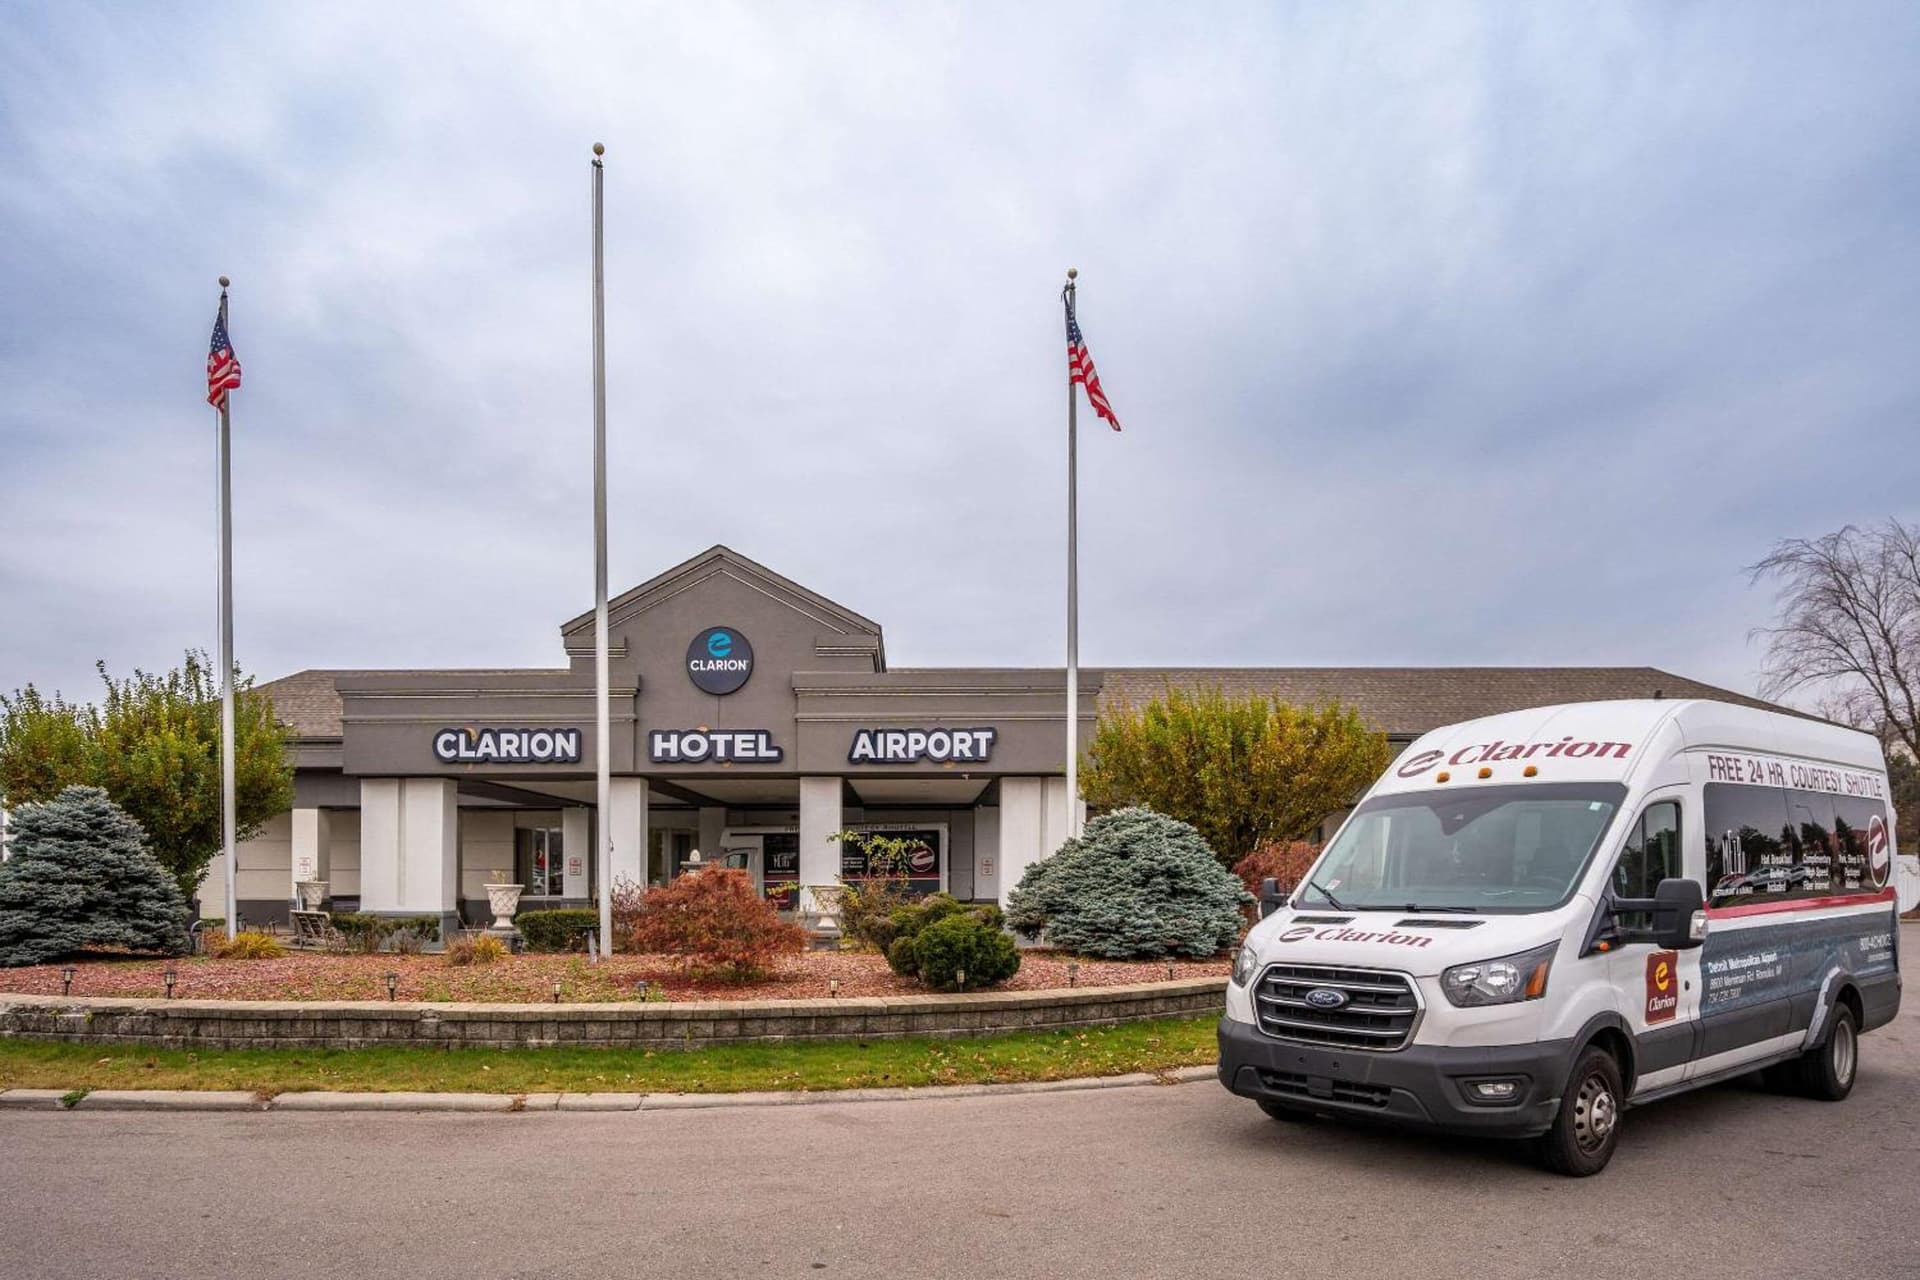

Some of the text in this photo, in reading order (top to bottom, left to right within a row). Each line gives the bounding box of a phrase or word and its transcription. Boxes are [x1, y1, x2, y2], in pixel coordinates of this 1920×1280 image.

[690, 659, 747, 672] CLARION
[436, 731, 993, 759] CLARION HOTEL AIRPORT
[1448, 736, 1633, 766] Clarion
[1707, 754, 1744, 782] FREE
[1747, 759, 1764, 784] 24
[1790, 765, 1841, 793] COURTESY
[1844, 772, 1883, 798] SHUTTLE
[1315, 927, 1433, 948] Clarion
[1648, 994, 1676, 1012] Clarion
